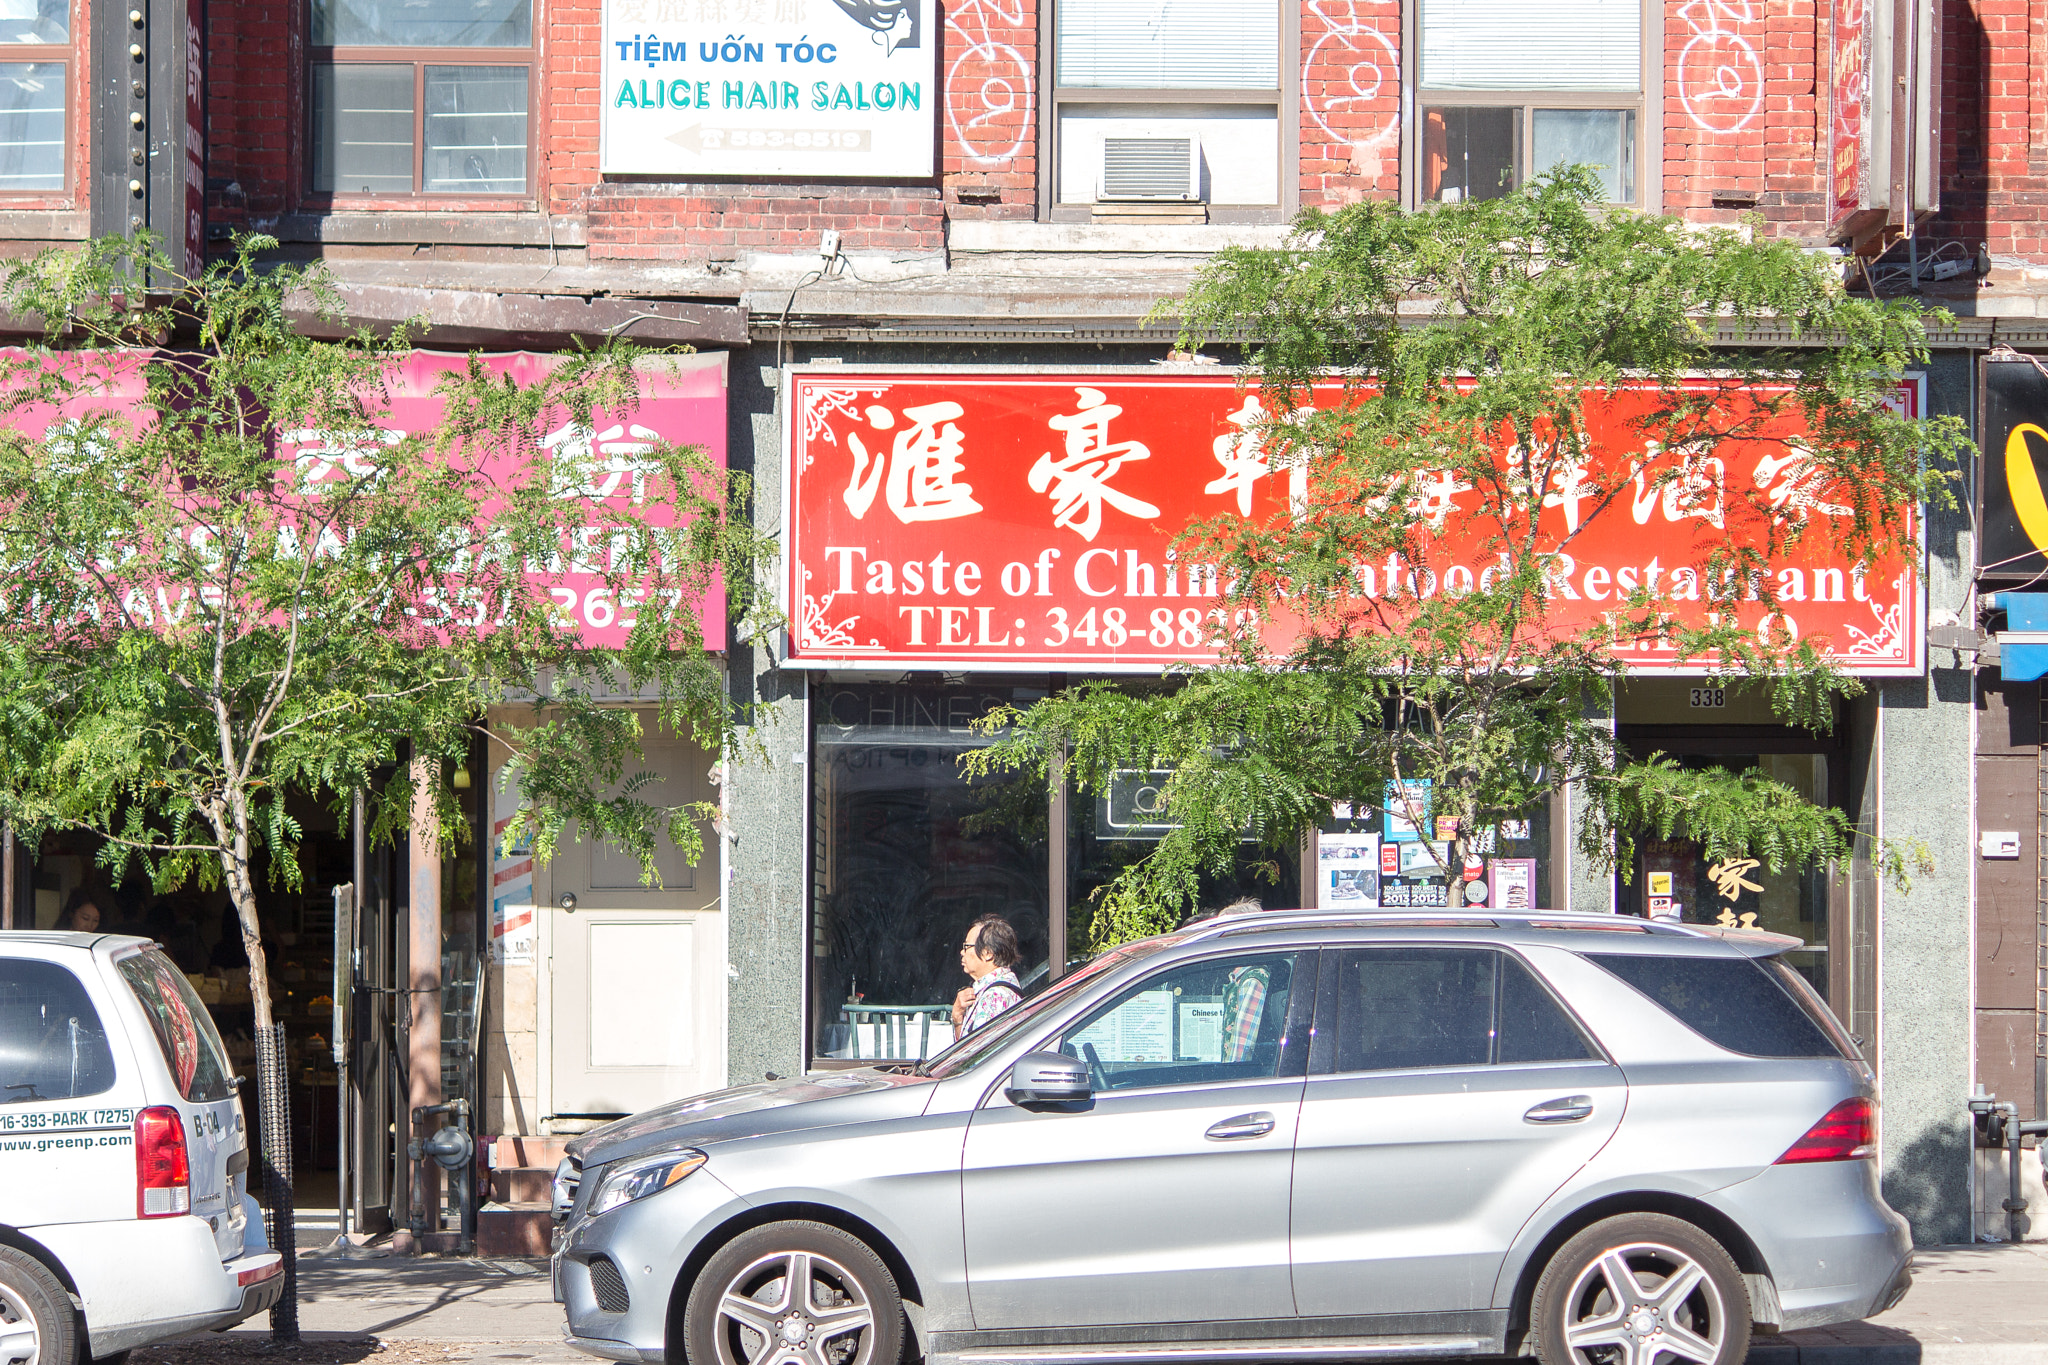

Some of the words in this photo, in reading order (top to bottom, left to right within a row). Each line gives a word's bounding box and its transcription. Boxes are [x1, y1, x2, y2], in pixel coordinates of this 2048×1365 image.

[776, 35, 837, 63] TÓC
[614, 79, 711, 111] ALICE
[722, 80, 799, 111] HAIR
[812, 81, 920, 112] SALON
[825, 546, 982, 597] Taste
[1001, 548, 1061, 597] of
[1275, 552, 1518, 600] afood
[1535, 553, 1871, 602] Restaurant
[899, 606, 1026, 648] TEL:
[1692, 689, 1724, 707] 338
[1383, 894, 1410, 903] 2013
[1411, 894, 1437, 903] 2012
[1192, 1009, 1218, 1017] Chinese
[94, 1109, 135, 1126] (7275)
[0, 1135, 132, 1152] ww.greenp.com
